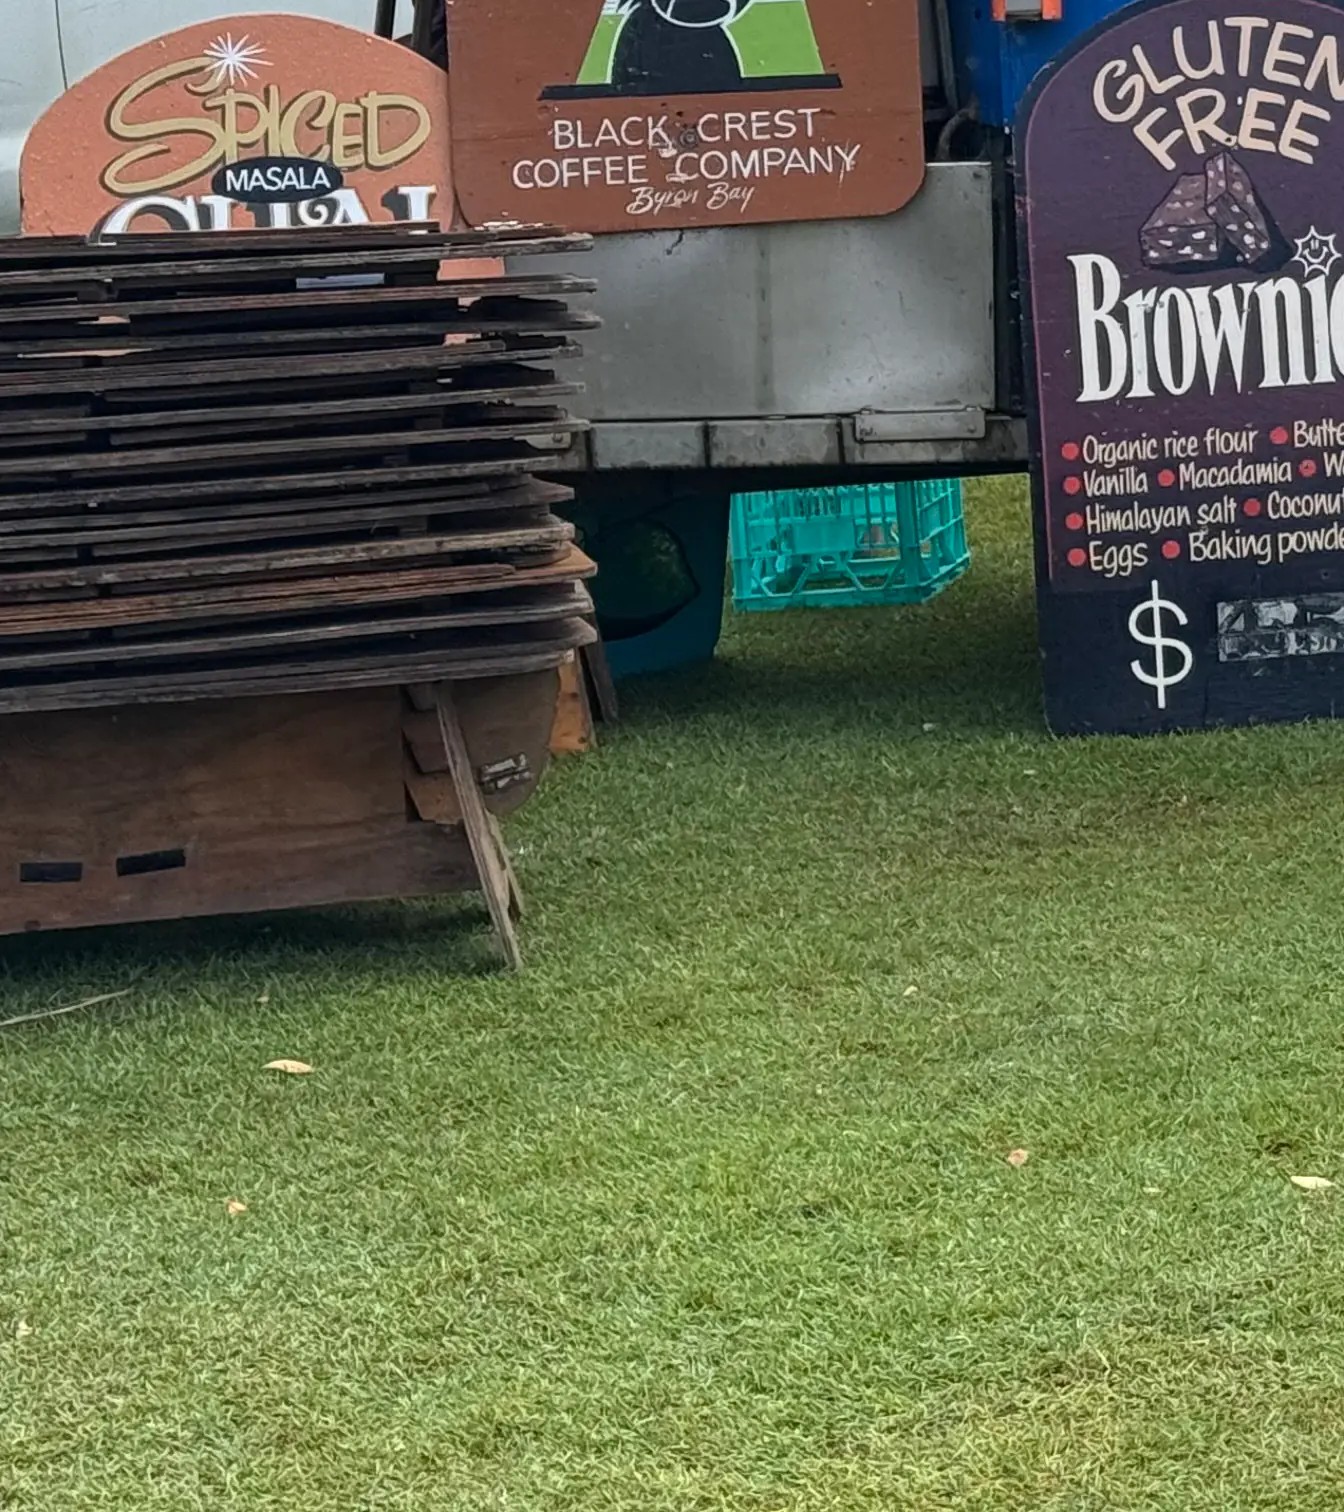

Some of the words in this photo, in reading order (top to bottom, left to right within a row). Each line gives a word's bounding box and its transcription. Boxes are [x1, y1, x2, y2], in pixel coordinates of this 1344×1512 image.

[552, 114, 669, 151] BLACK
[696, 108, 822, 143] CREST
[1132, 88, 1332, 171] FREE
[225, 166, 332, 192] MASALA
[511, 155, 649, 189] COFFEE
[670, 143, 862, 183] COMPANY
[626, 187, 699, 215] Byron
[706, 183, 756, 213] Bay
[1082, 434, 1159, 469] Organic
[1163, 431, 1199, 459] rice
[1205, 426, 1259, 457] flour
[1082, 468, 1149, 499] Vanilla
[1178, 459, 1293, 492] Macadamia
[1084, 502, 1192, 537] Himalayan
[1196, 496, 1238, 528] salt
[1088, 540, 1149, 579] Eggs
[1187, 529, 1272, 565] Baking
[1127, 578, 1194, 710] $
